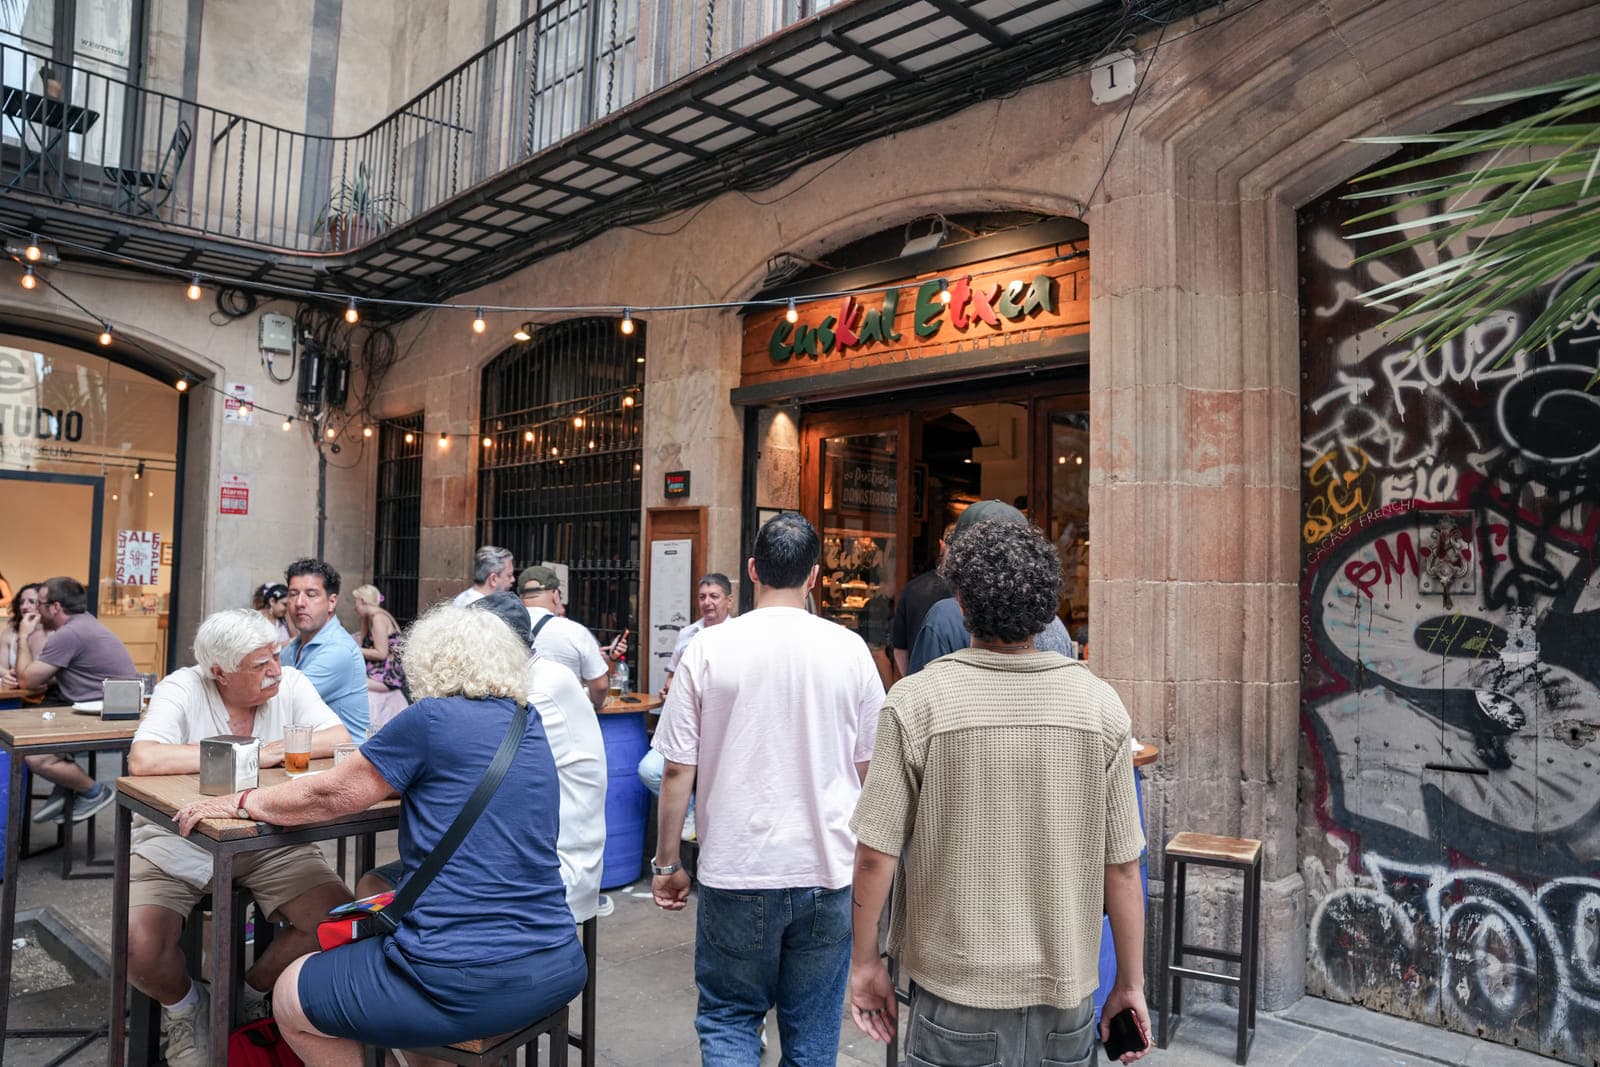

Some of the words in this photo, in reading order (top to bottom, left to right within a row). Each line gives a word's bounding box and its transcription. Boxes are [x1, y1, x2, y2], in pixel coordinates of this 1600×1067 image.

[1107, 64, 1117, 89] 1
[914, 275, 1053, 337] Etxea
[119, 531, 160, 543] SALE
[116, 574, 158, 586] SALE
